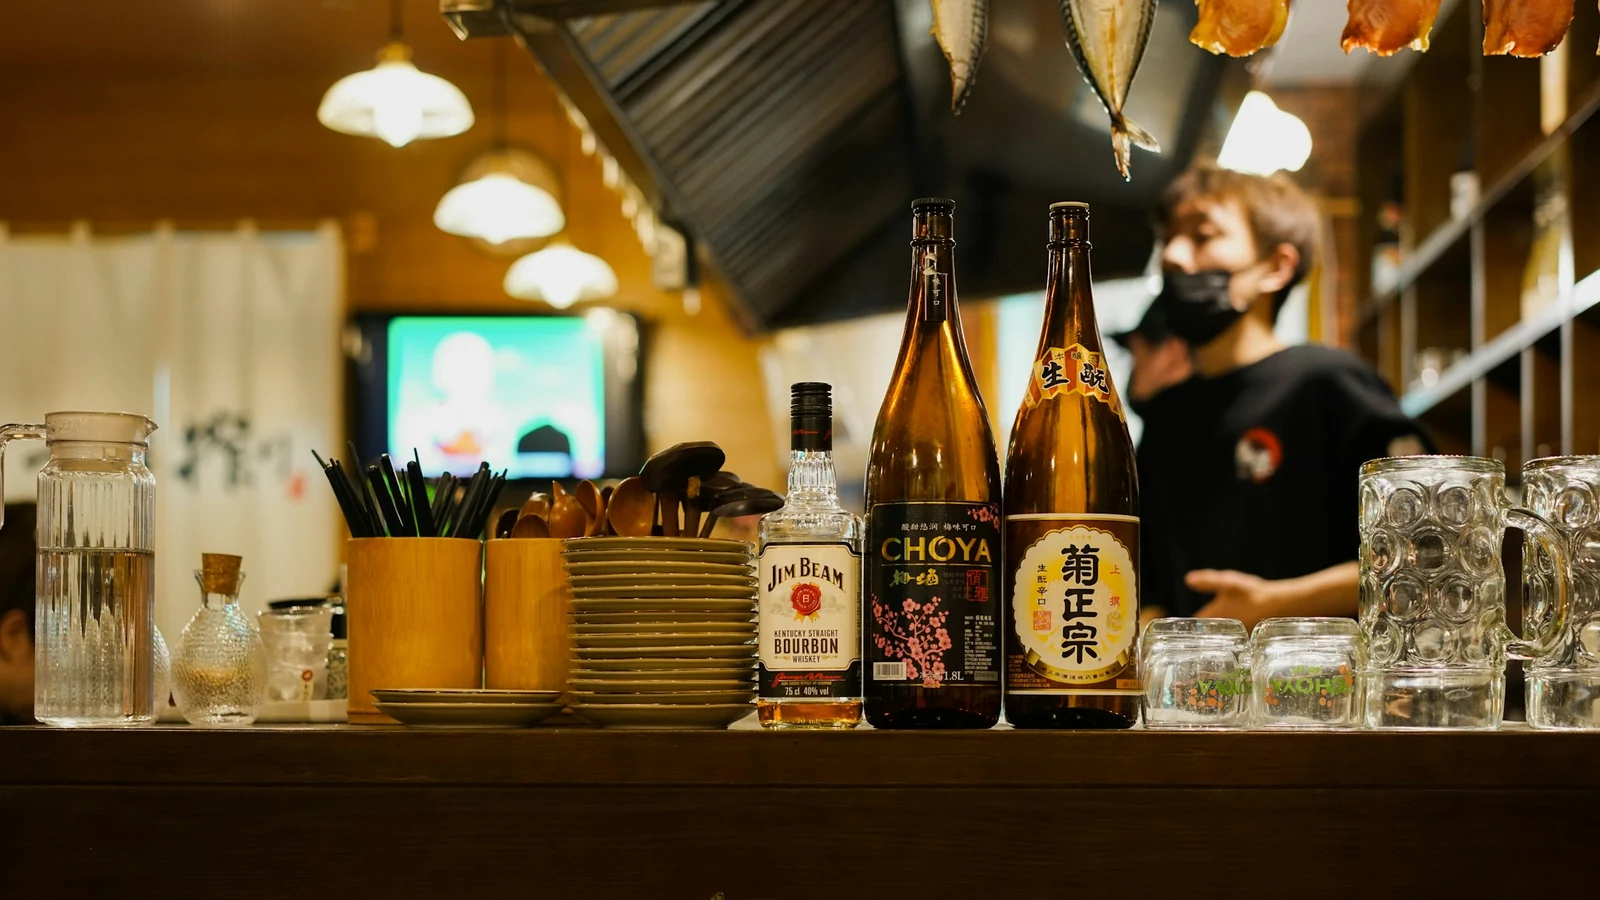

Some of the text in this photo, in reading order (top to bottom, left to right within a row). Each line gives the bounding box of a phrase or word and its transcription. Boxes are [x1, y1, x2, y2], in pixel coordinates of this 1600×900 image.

[881, 535, 992, 563] CHOYA
[768, 557, 844, 593] JIM BEAM
[1110, 564, 1121, 607] 上撰
[1061, 543, 1100, 665] 菊正宗
[774, 629, 838, 638] KENTUCKY STRAIGHT
[774, 638, 838, 654] BOURBON
[792, 655, 820, 663] WHISKEY
[943, 670, 965, 681] 1.8L
[785, 686, 829, 696] 75 cl 40% vol
